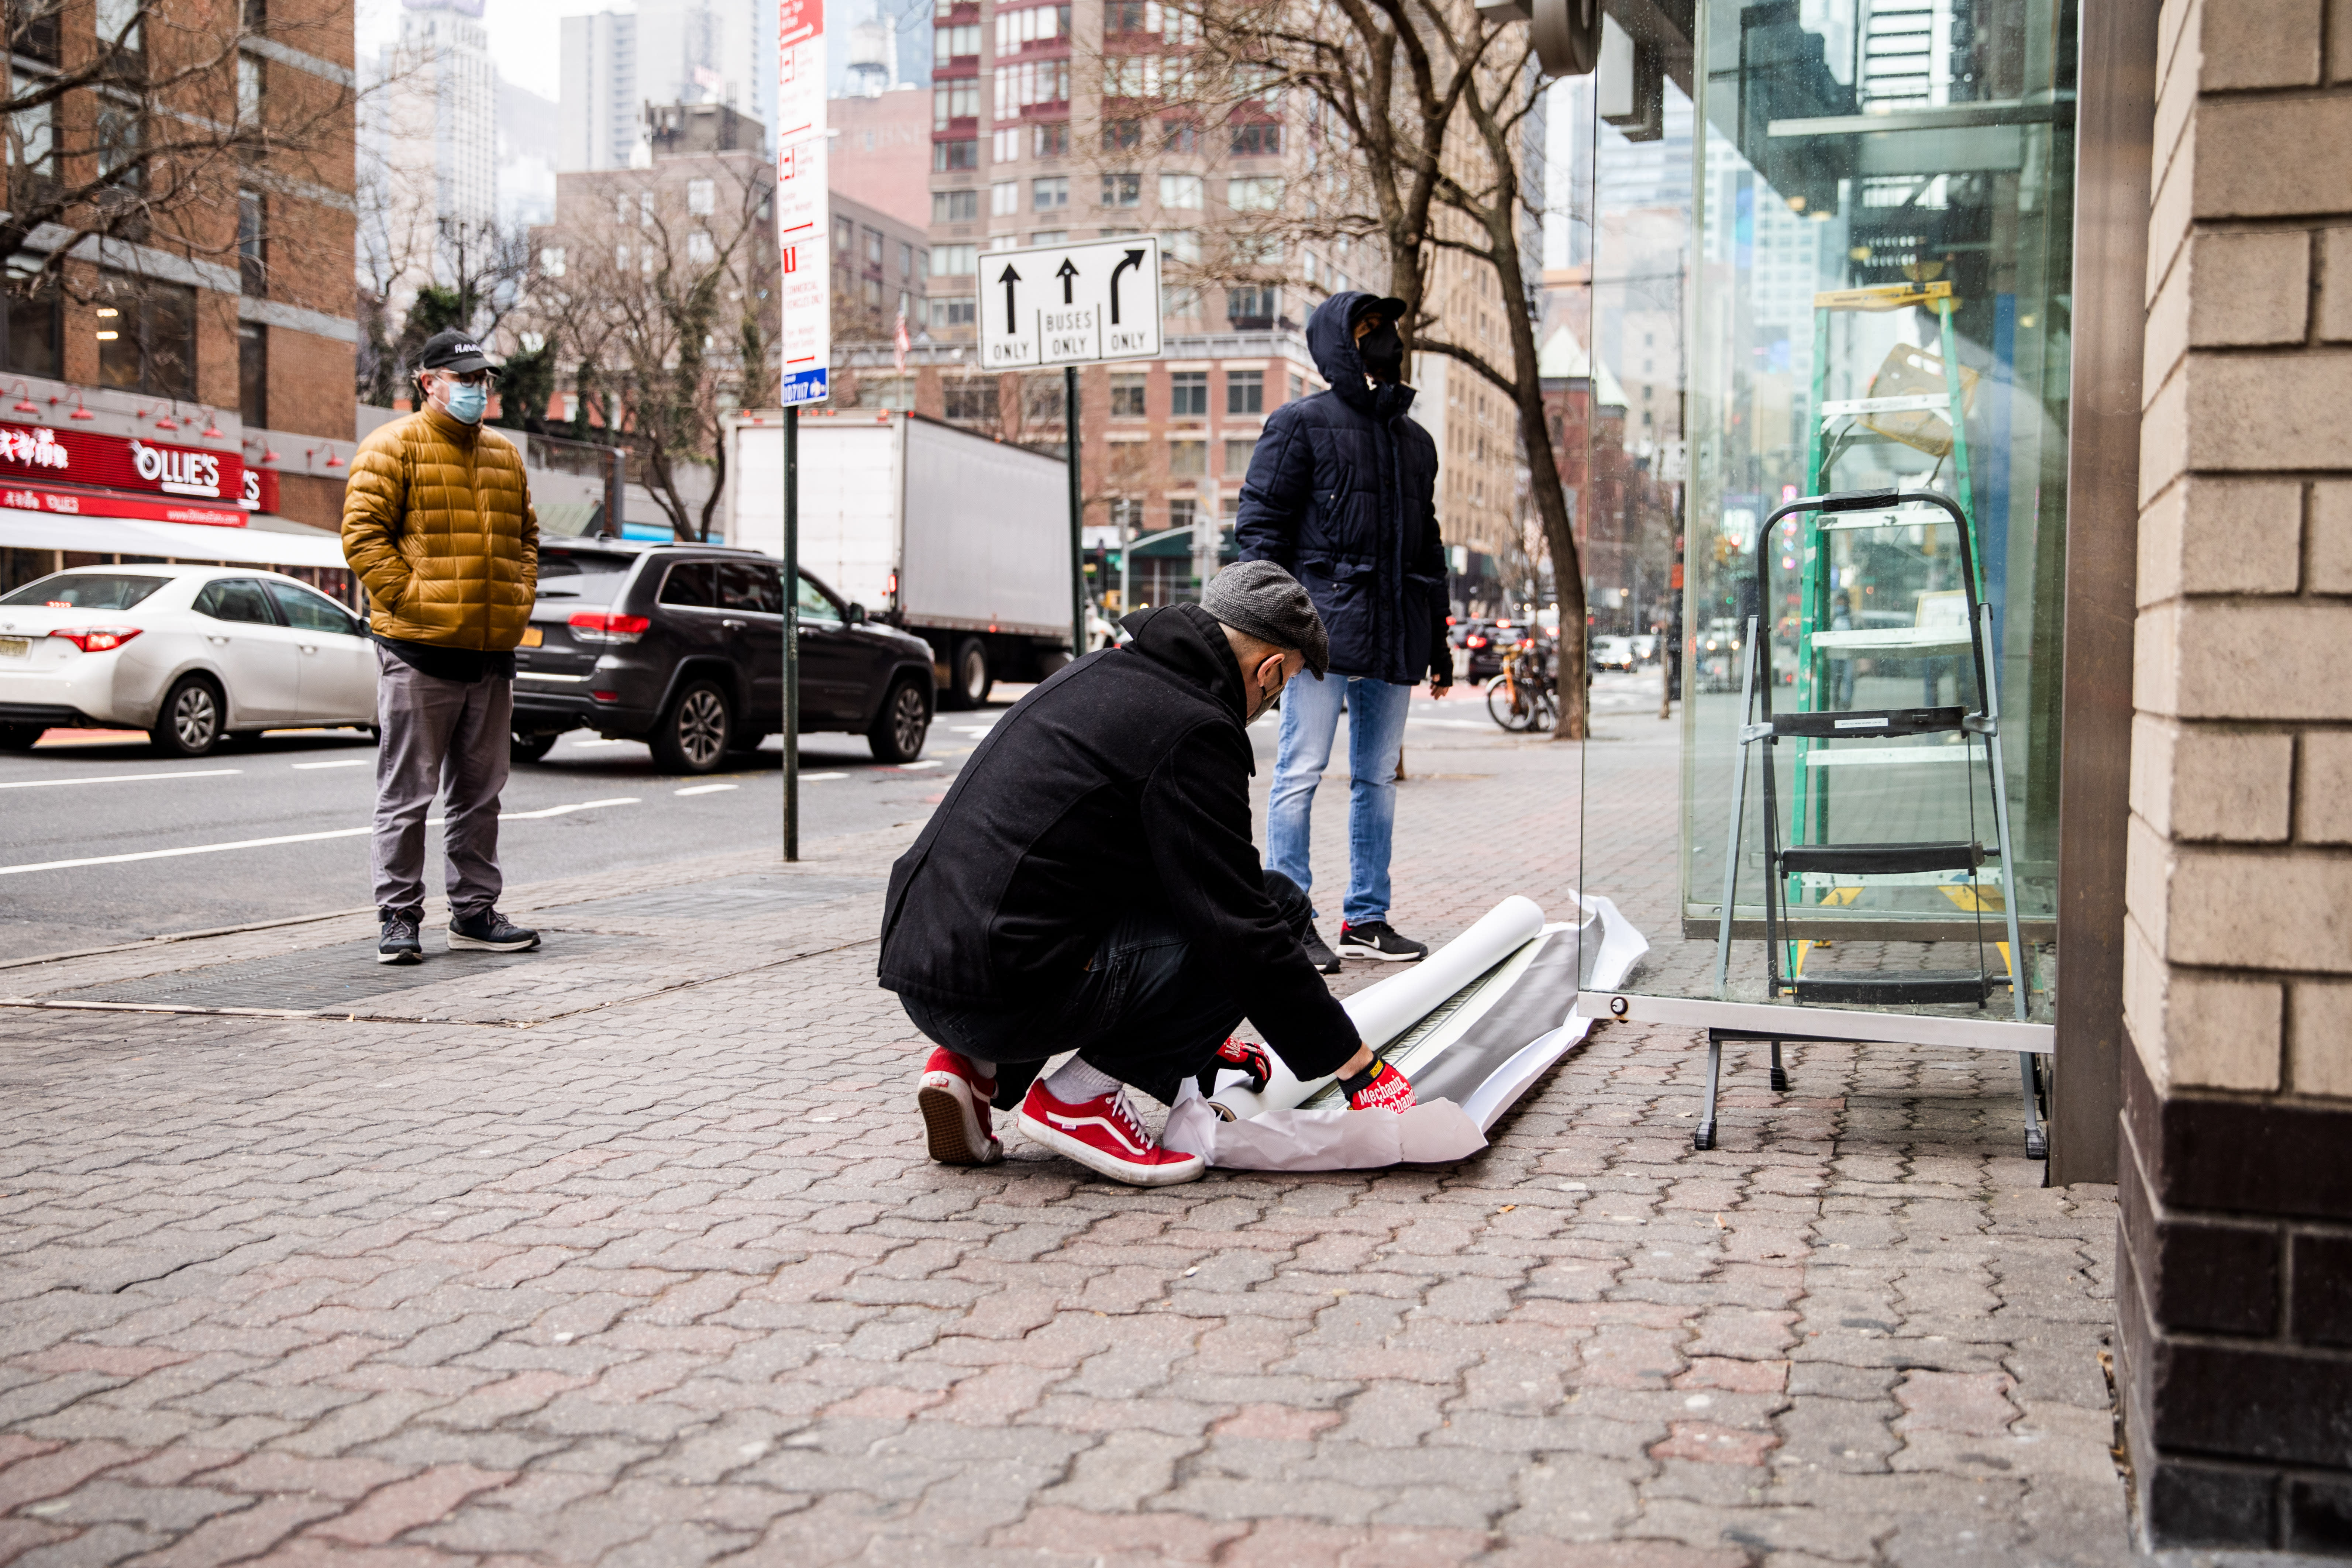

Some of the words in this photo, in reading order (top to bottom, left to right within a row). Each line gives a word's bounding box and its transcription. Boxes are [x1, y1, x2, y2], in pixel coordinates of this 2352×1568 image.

[1046, 312, 1092, 332] BUSES
[994, 341, 1029, 360] ONLY
[1053, 337, 1087, 356] ONLY
[1111, 332, 1146, 351] ONLY
[131, 440, 219, 487] OLLIE'S
[1358, 1075, 1407, 1105] Mechanix
